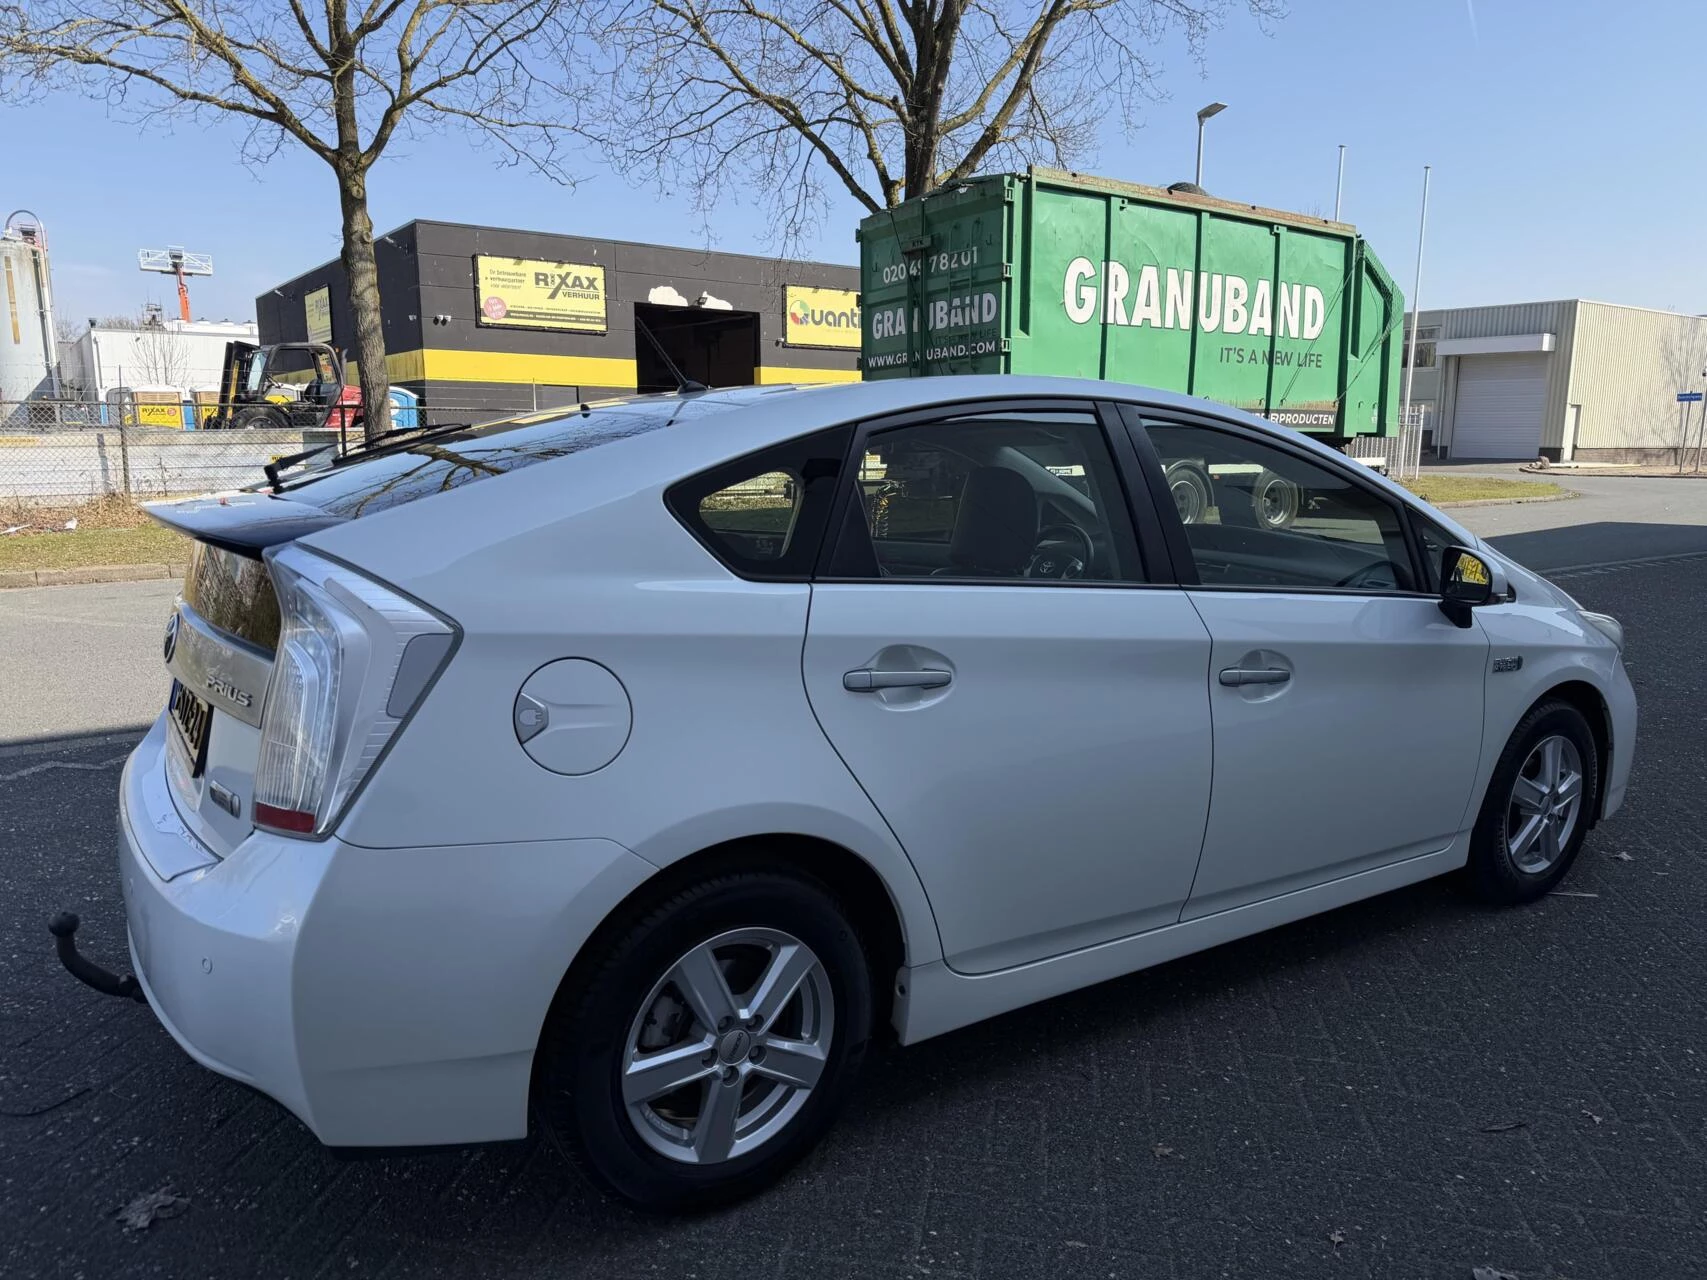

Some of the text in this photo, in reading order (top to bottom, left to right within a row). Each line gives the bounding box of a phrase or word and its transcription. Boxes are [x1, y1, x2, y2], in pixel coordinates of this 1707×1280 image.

[883, 263, 907, 284] 020
[562, 291, 600, 300] VERHUUR
[1063, 256, 1325, 340] GRANUBAND
[1220, 347, 1245, 364] IT'S
[1248, 349, 1258, 365] A
[1297, 352, 1323, 369] LIFE
[1252, 412, 1335, 425] ERPRODUCTEN
